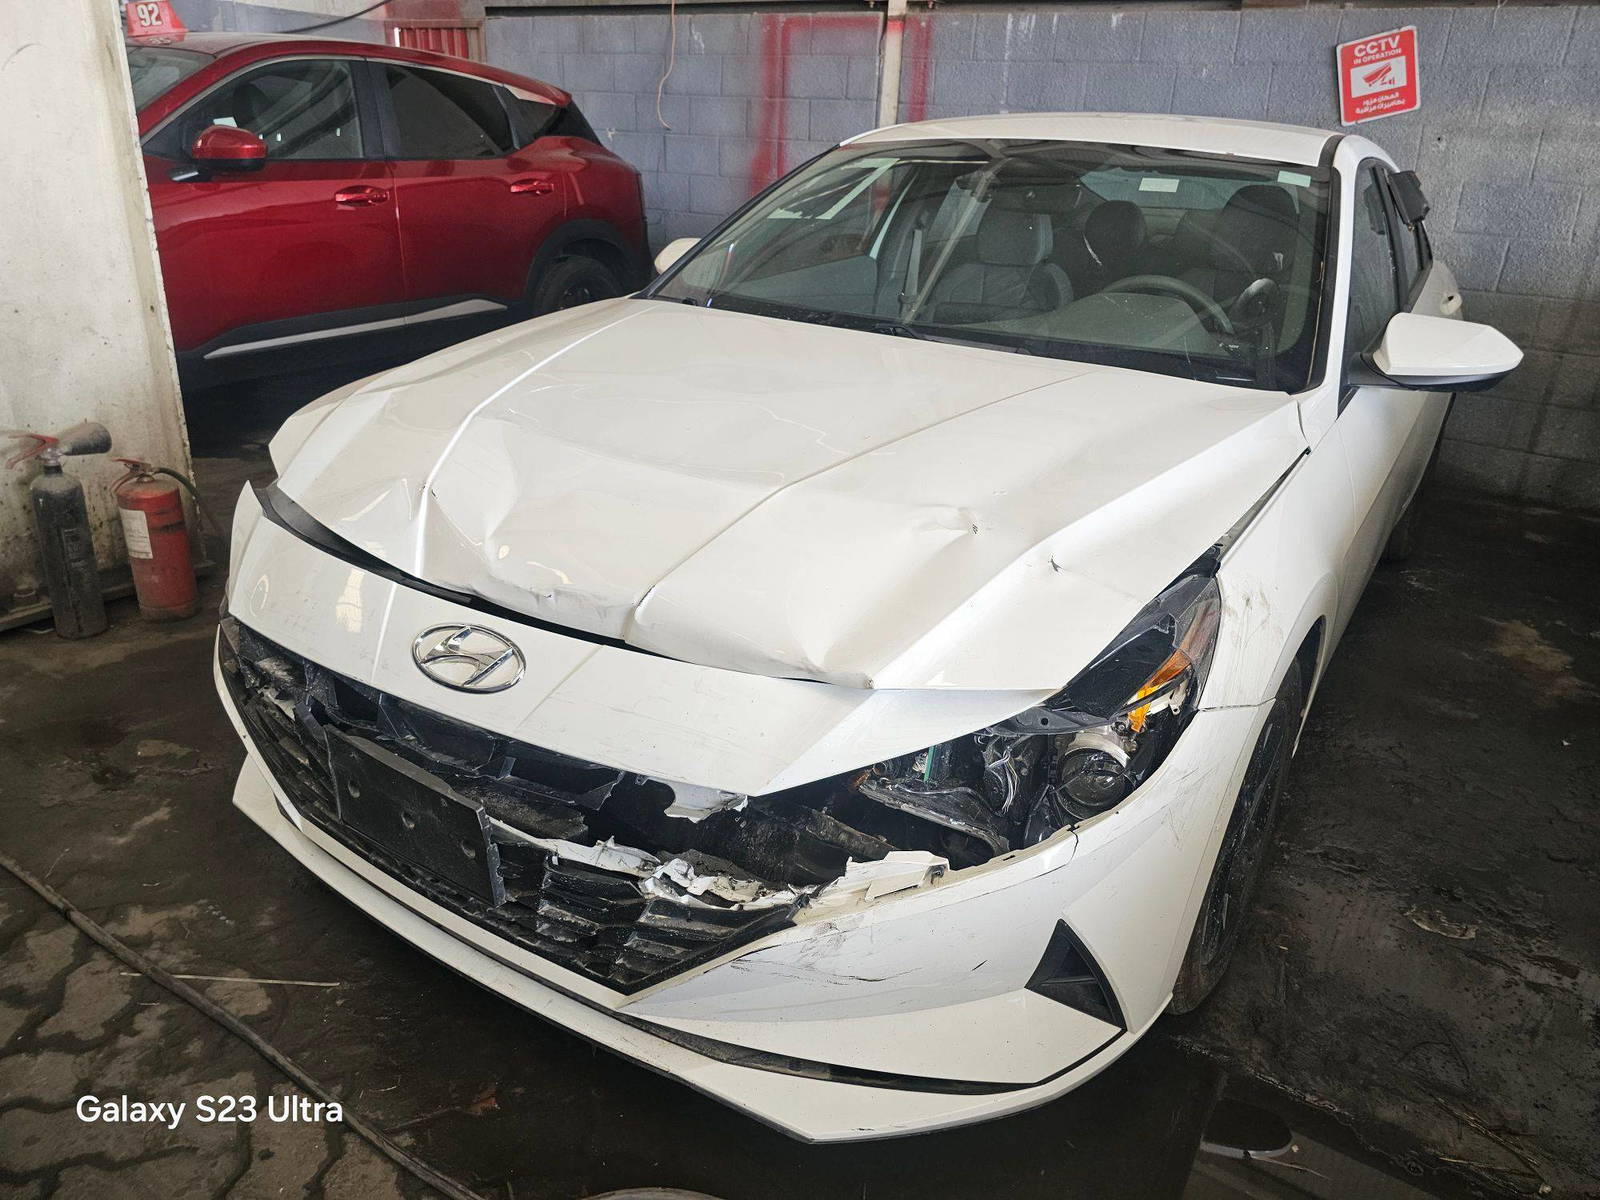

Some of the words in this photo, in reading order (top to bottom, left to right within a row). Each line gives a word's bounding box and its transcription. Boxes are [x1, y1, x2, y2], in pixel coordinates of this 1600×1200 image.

[136, 3, 163, 27] 92
[1353, 34, 1400, 57] CCTV
[1362, 48, 1402, 62] OPERATION
